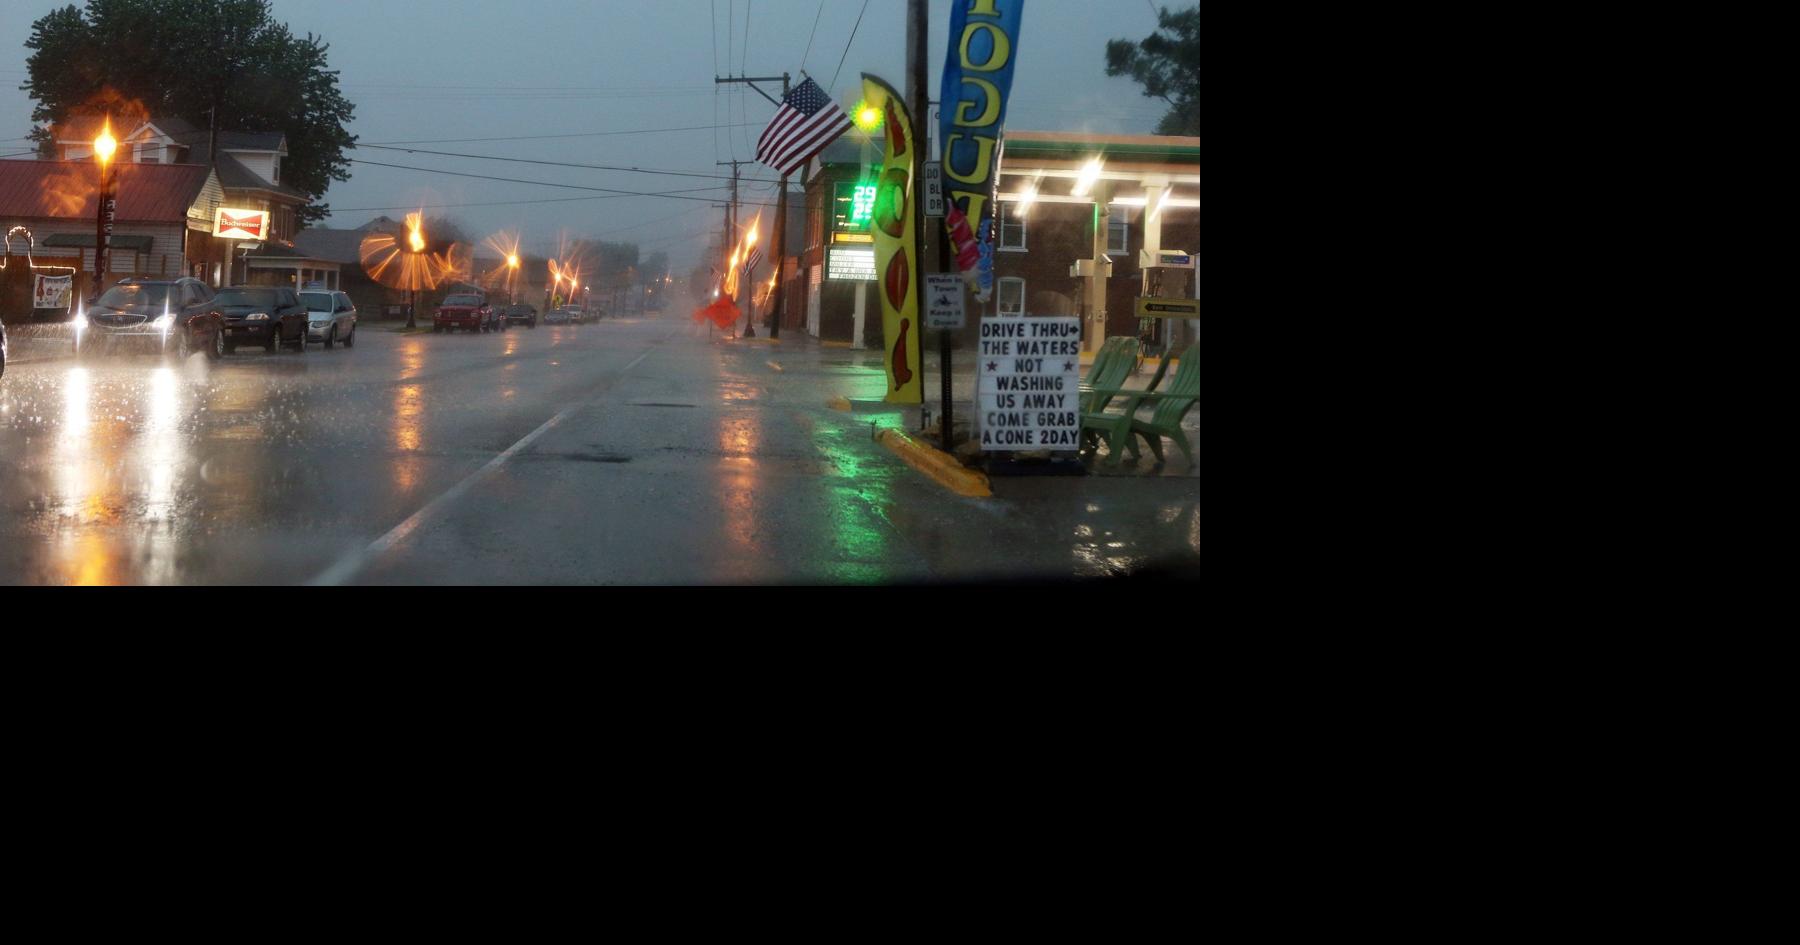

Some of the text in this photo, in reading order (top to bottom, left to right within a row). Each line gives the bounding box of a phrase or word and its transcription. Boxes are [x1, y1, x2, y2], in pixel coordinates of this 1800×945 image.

[982, 323, 1069, 337] DRIVE THRU
[982, 341, 1078, 355] THE WATERS
[1015, 359, 1044, 373] NOT
[996, 377, 1063, 391] WASHING
[996, 394, 1066, 409] US AWAY
[987, 412, 1075, 426] COME GRAB
[982, 430, 1078, 445] A CONE 2DAY
